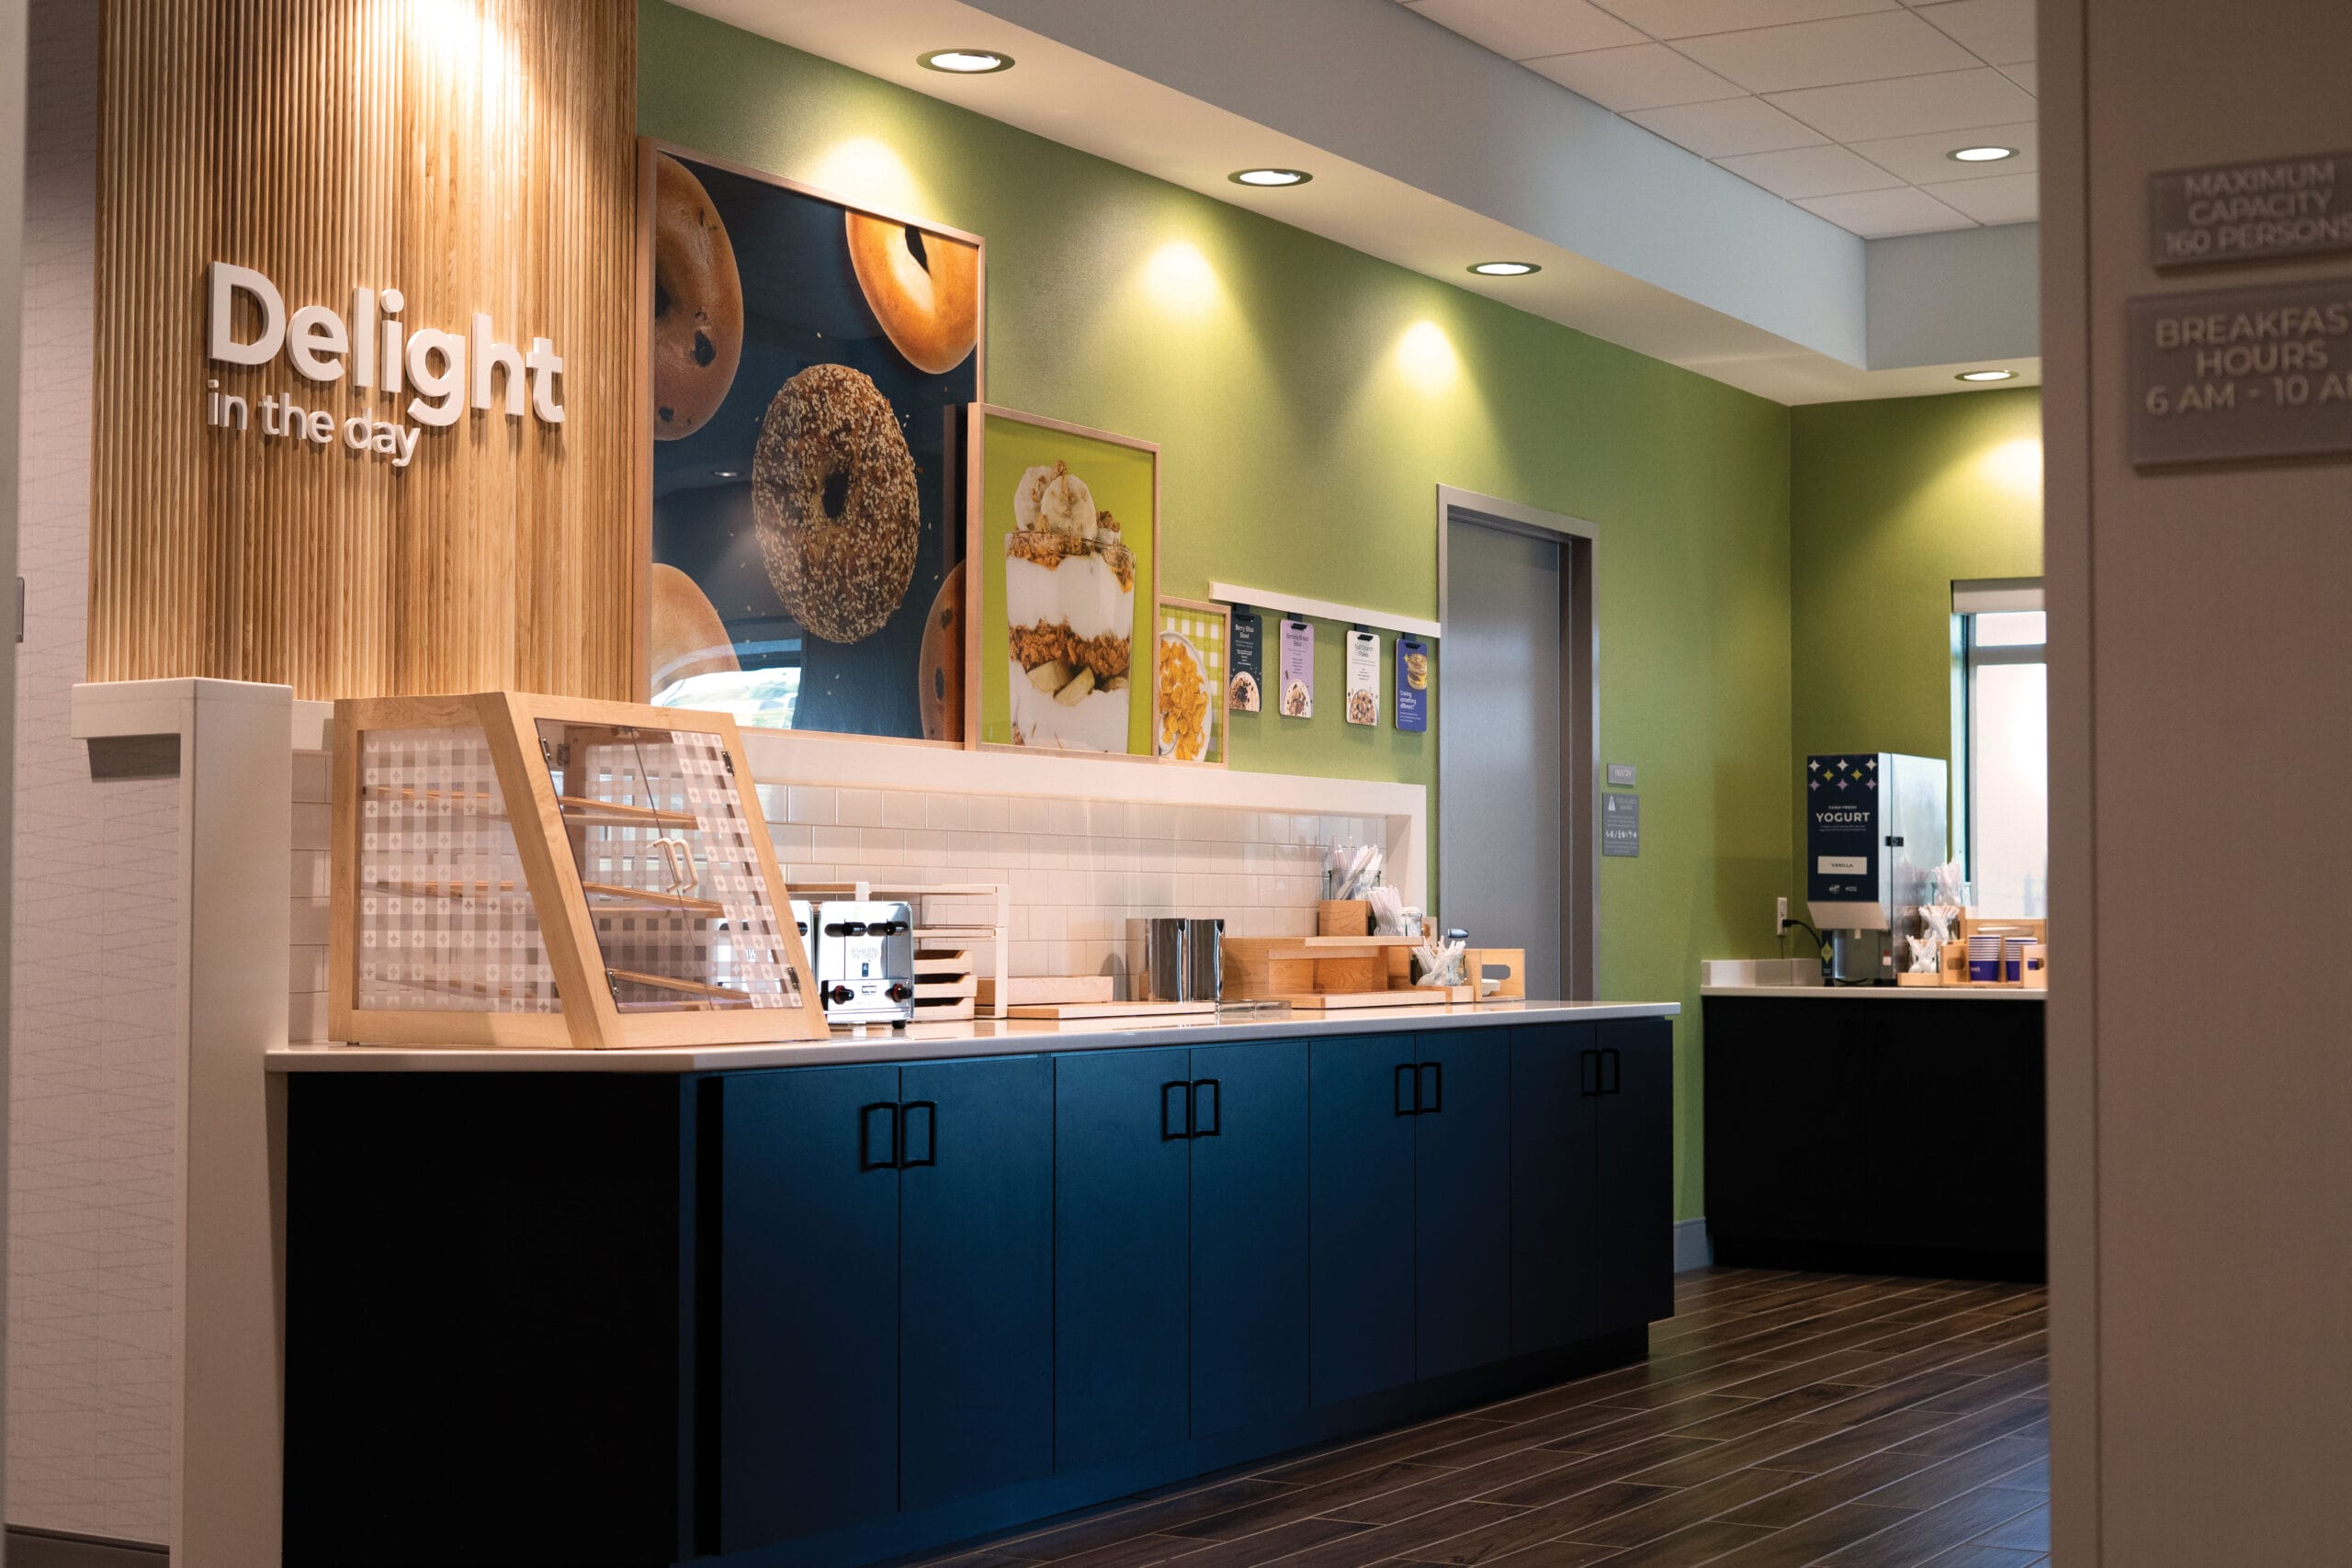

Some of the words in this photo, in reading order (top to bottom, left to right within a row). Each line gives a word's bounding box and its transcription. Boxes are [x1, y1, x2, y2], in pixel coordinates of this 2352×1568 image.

[2185, 161, 2335, 198] MAXIMUM
[2187, 189, 2334, 226] CAPACITY
[2164, 229, 2211, 256] 160
[208, 261, 566, 426] Delight
[2155, 301, 2352, 349] BREAKFAS
[2196, 338, 2330, 378] HOURS
[2144, 384, 2170, 415] 6
[2176, 380, 2236, 414] AM
[2273, 373, 2310, 407] 10
[207, 379, 248, 431] in
[258, 392, 334, 444] the
[343, 407, 422, 468] day
[1815, 812, 1870, 822] YOGURT
